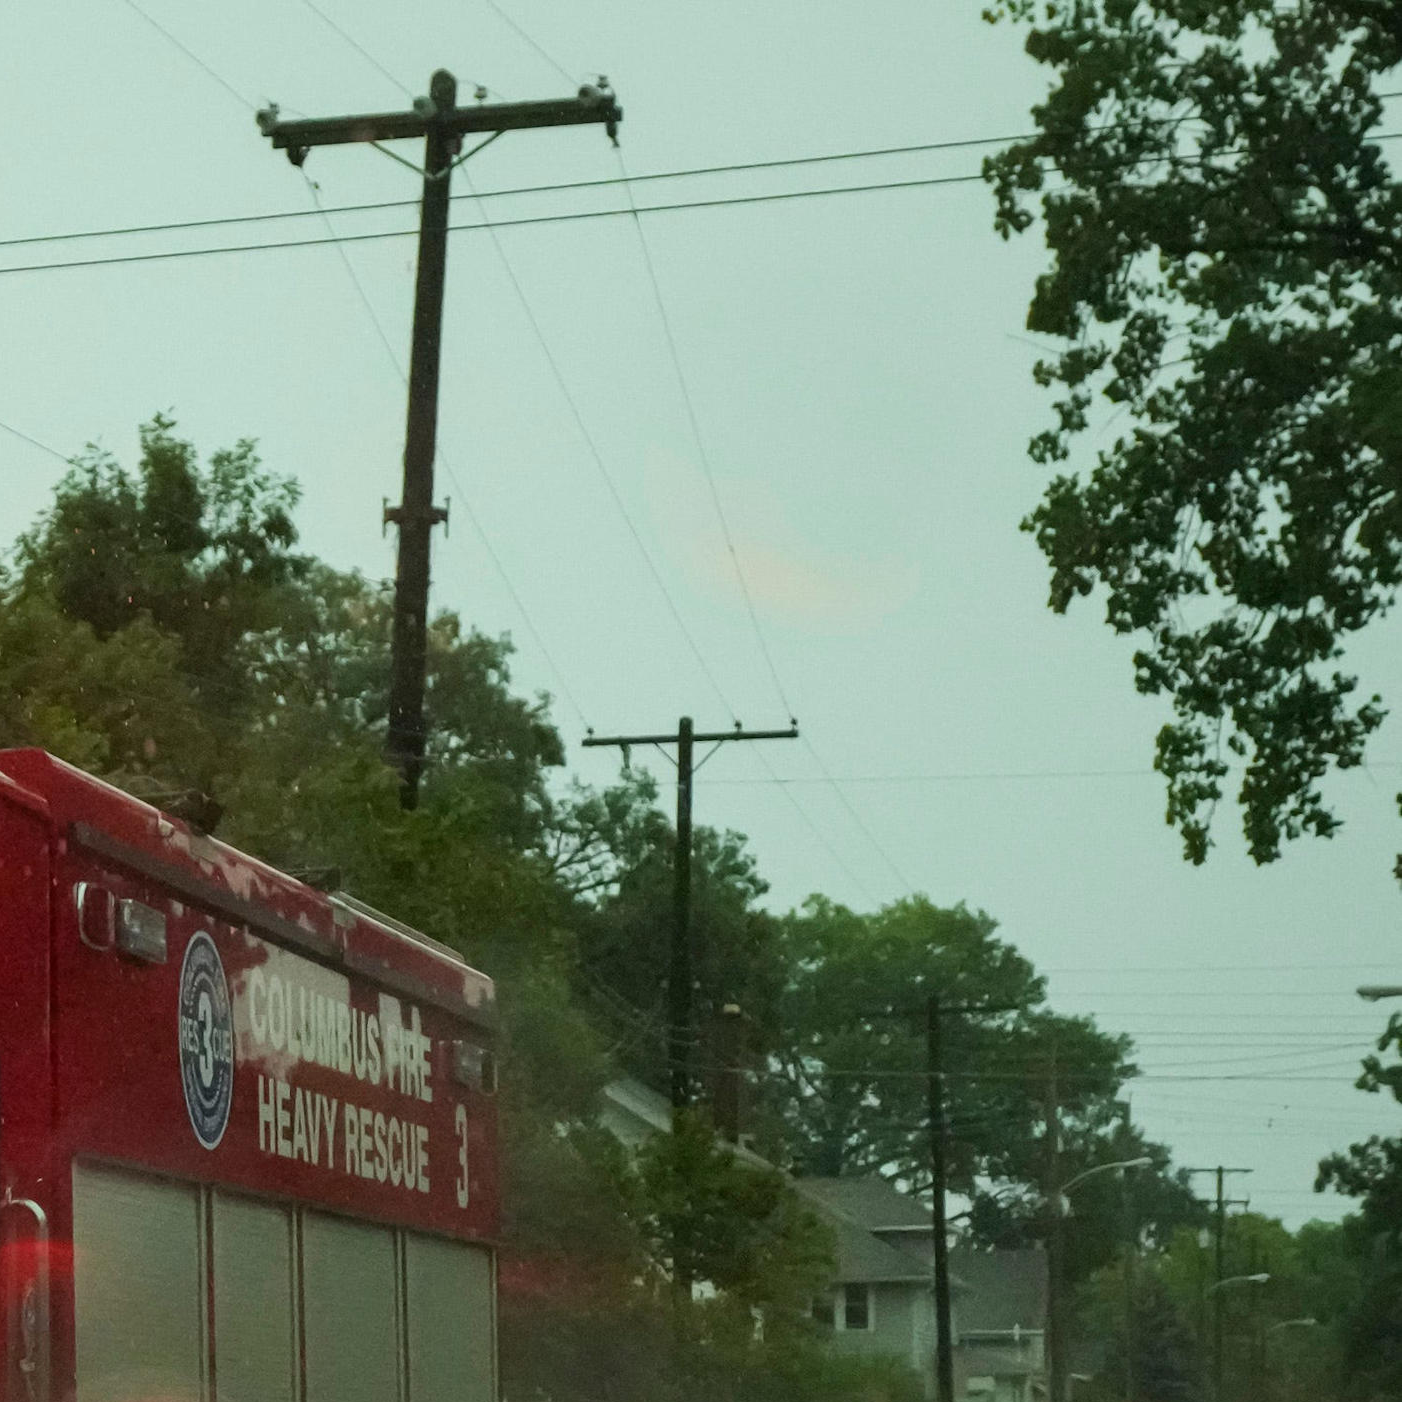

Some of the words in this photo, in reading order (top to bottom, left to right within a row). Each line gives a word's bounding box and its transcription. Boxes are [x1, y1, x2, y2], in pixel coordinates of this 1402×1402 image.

[198, 991, 214, 1089] 3
[249, 965, 381, 1085] COLUMBUS
[385, 1022, 434, 1103] FIRE
[258, 1074, 339, 1170] HEAVY
[345, 1102, 430, 1193] RESCUE
[454, 1102, 470, 1210] 3
